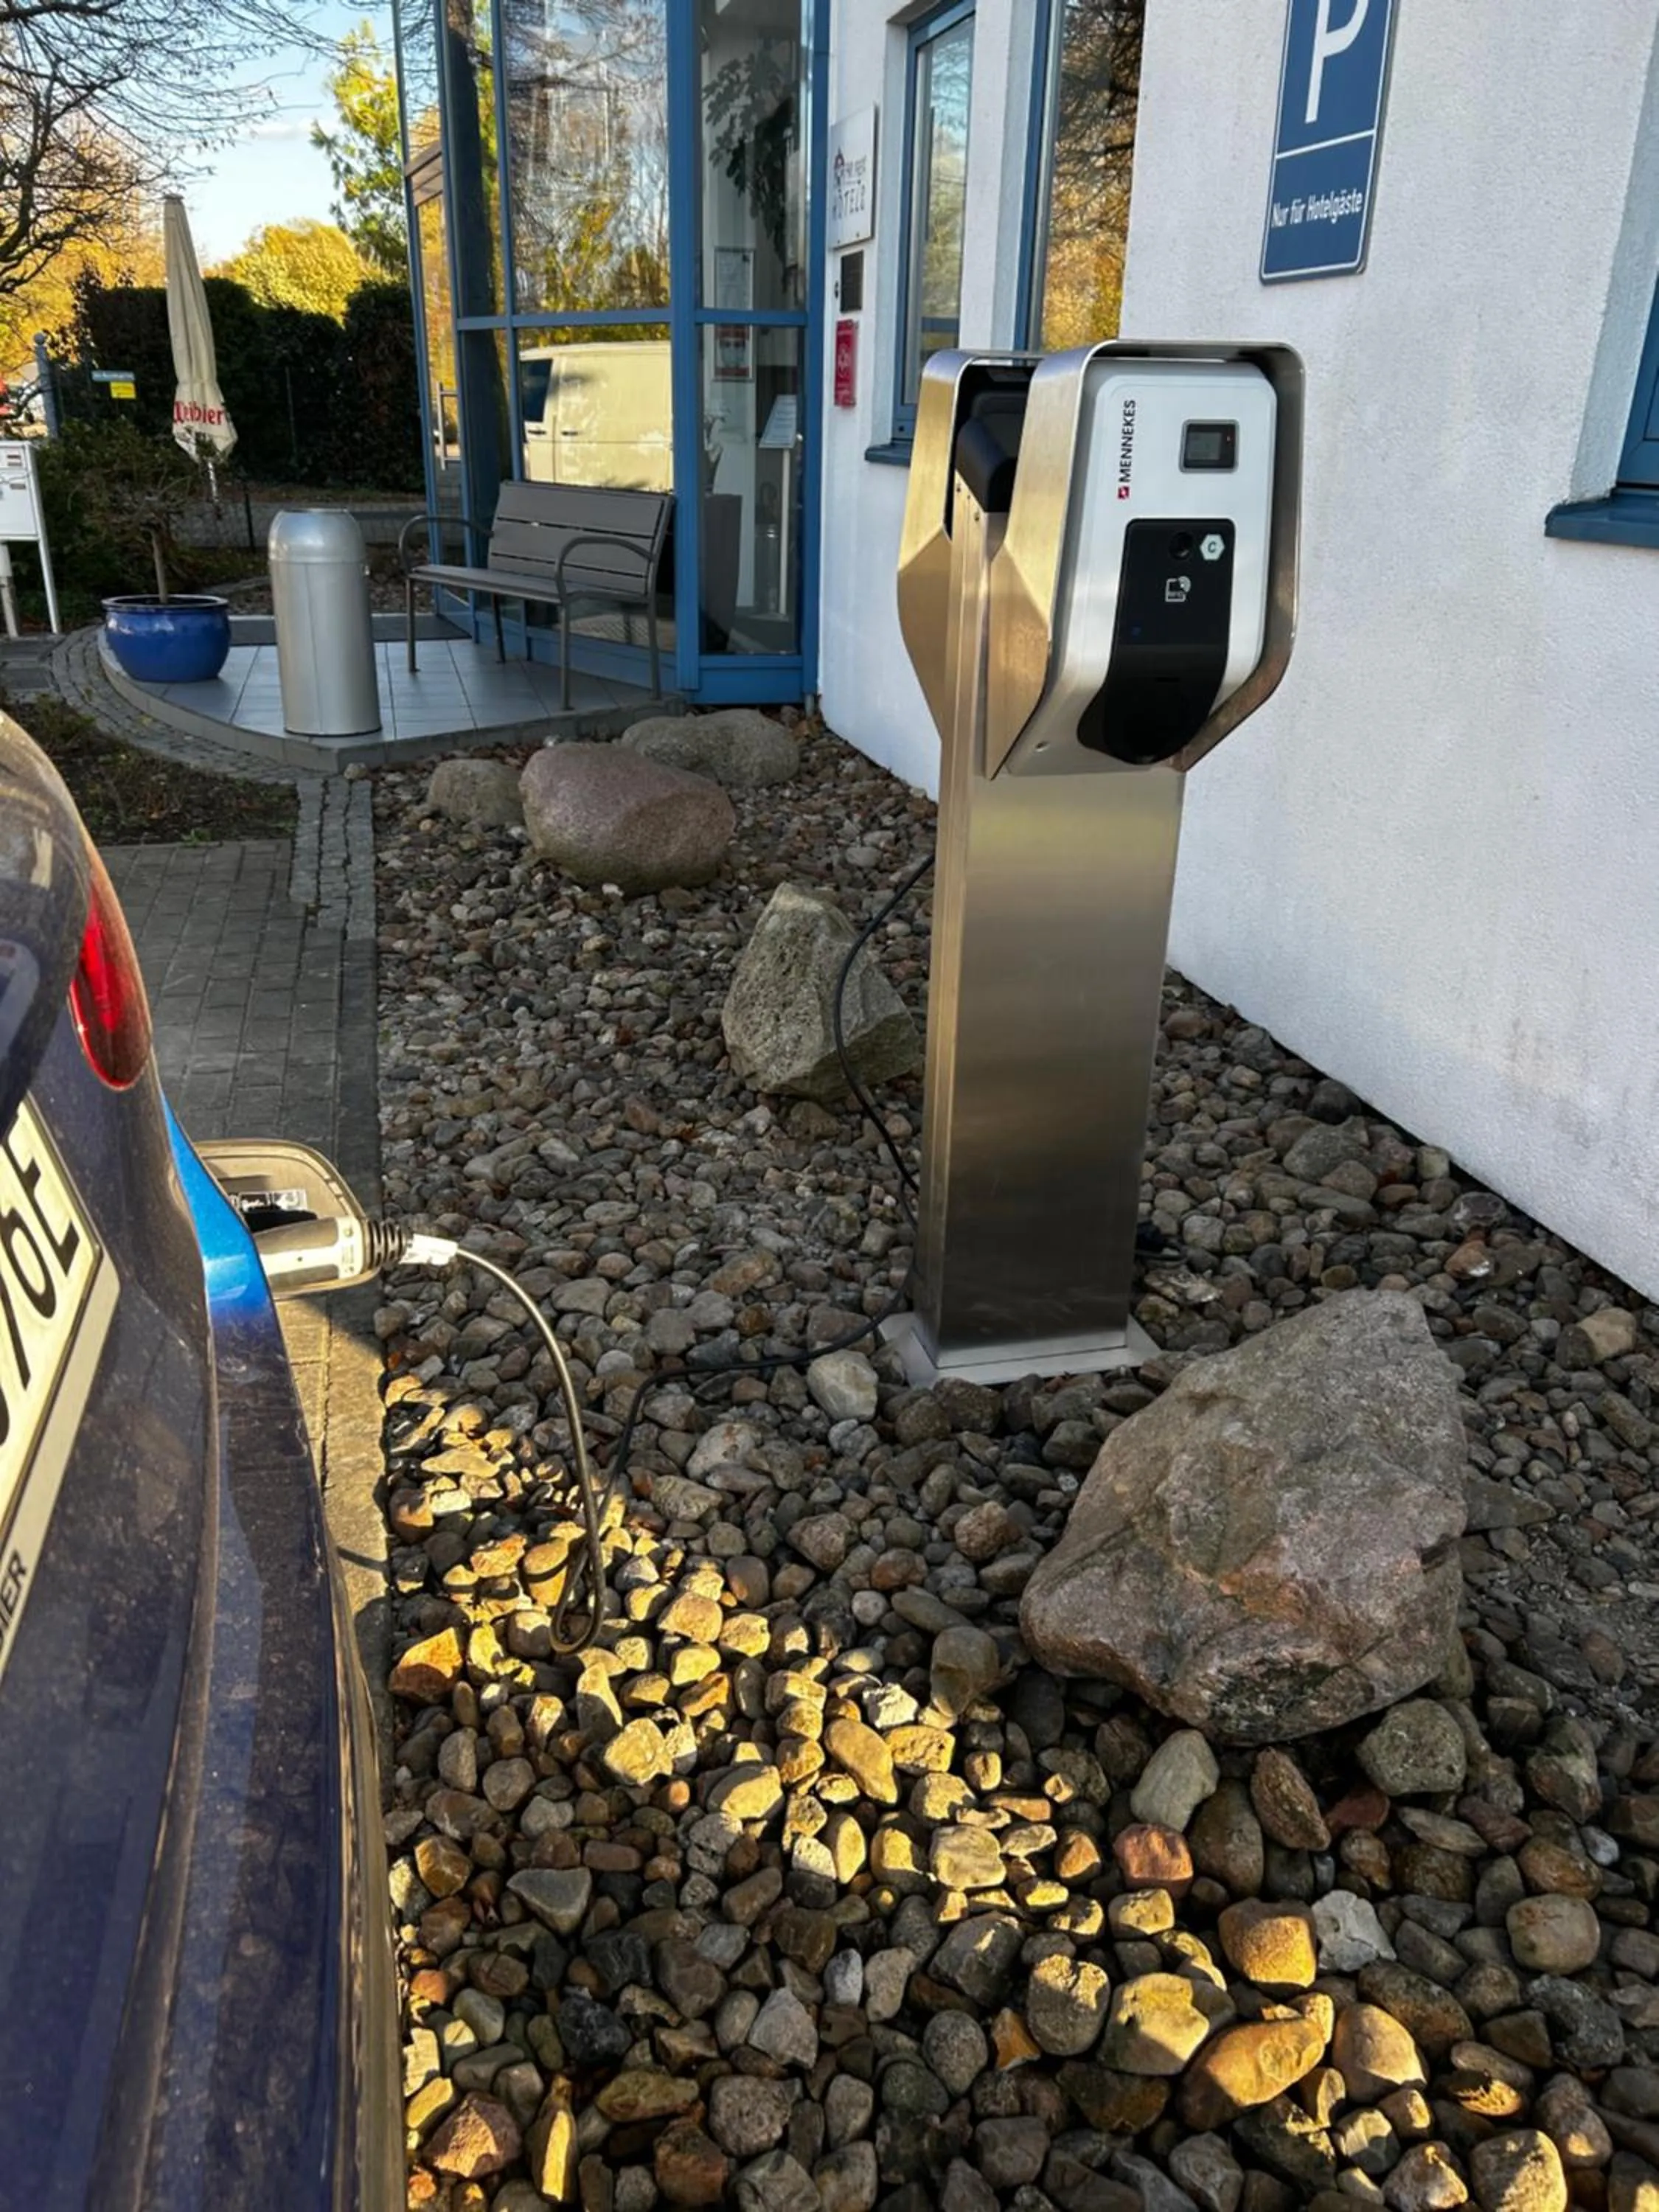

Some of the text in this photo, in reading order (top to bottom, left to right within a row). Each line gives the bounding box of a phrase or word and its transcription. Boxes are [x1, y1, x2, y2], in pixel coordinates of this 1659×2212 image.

[1305, 0, 1369, 124] P
[1271, 187, 1363, 228] Nur für Hotelgäste
[1118, 399, 1136, 483] MENNEKES
